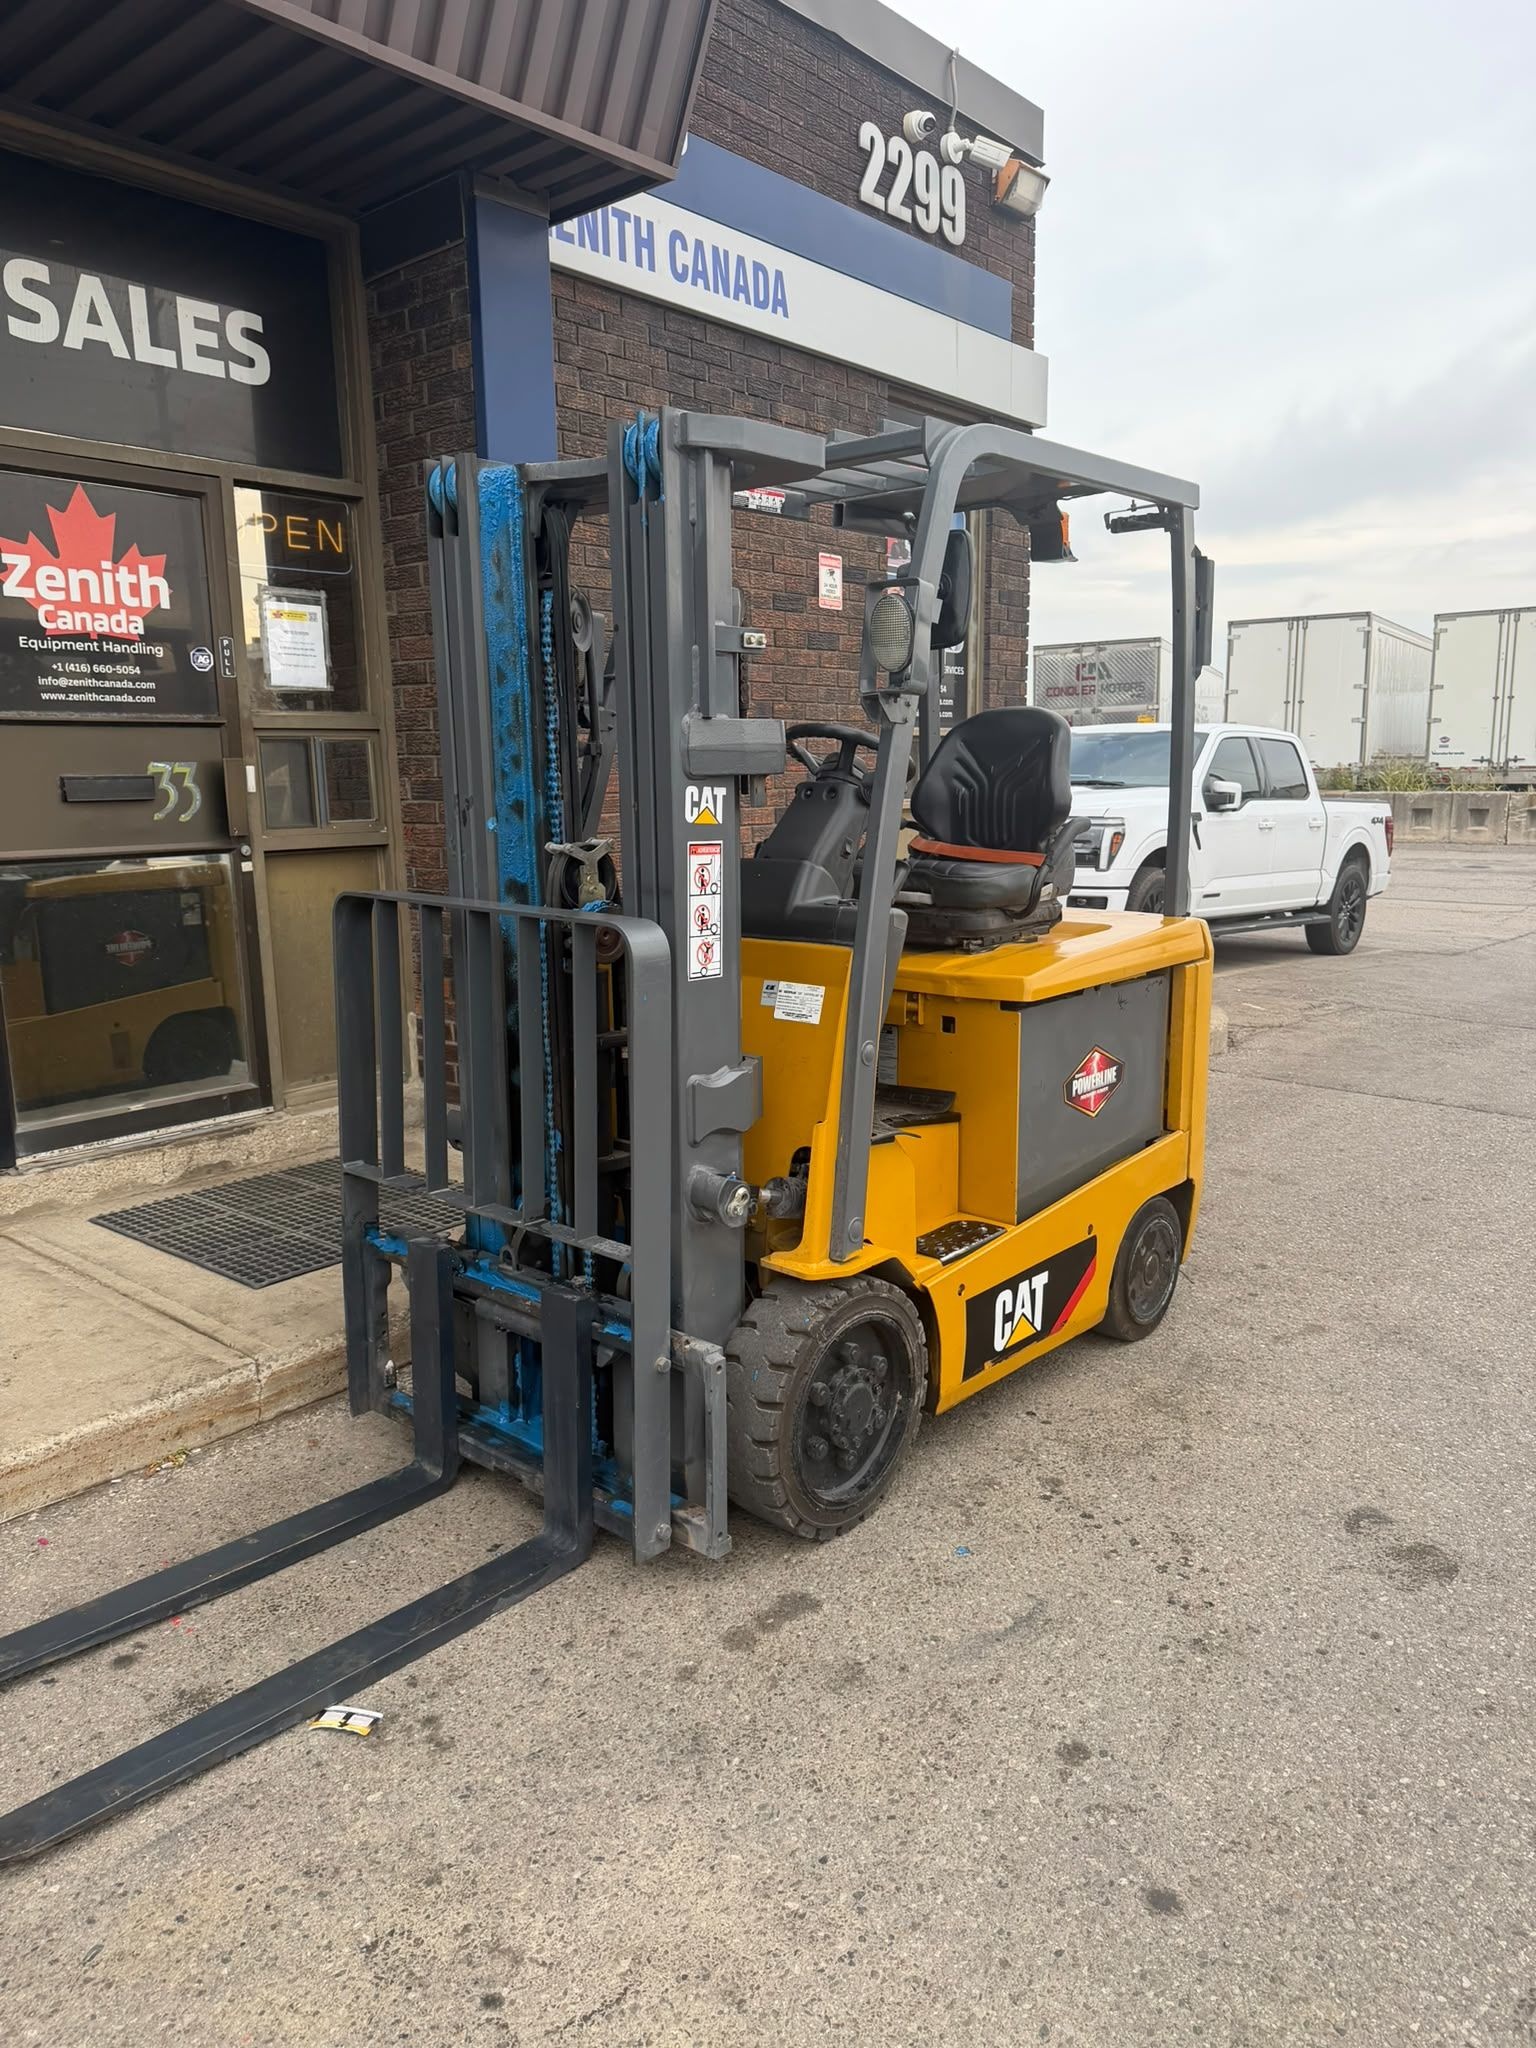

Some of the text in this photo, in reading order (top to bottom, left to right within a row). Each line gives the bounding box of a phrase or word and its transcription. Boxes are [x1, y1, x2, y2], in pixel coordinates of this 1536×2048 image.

[859, 121, 966, 246] 2299
[548, 206, 790, 319] NITH CANADA
[3, 258, 271, 386] SALES
[238, 511, 343, 553] PEN
[1, 552, 171, 610] Zenith
[38, 603, 145, 635] Canada
[18, 636, 164, 657] Equipment Handling
[223, 639, 231, 675] PULL
[38, 676, 156, 689] info@zenithcanada.com
[52, 662, 141, 675] +1 (416) 660-5054
[40, 692, 156, 703] www.zenithcanada.com
[147, 761, 202, 822] 33
[685, 785, 727, 824] CAT
[1072, 1065, 1118, 1097] POWERLINE
[994, 1270, 1049, 1352] CAT
